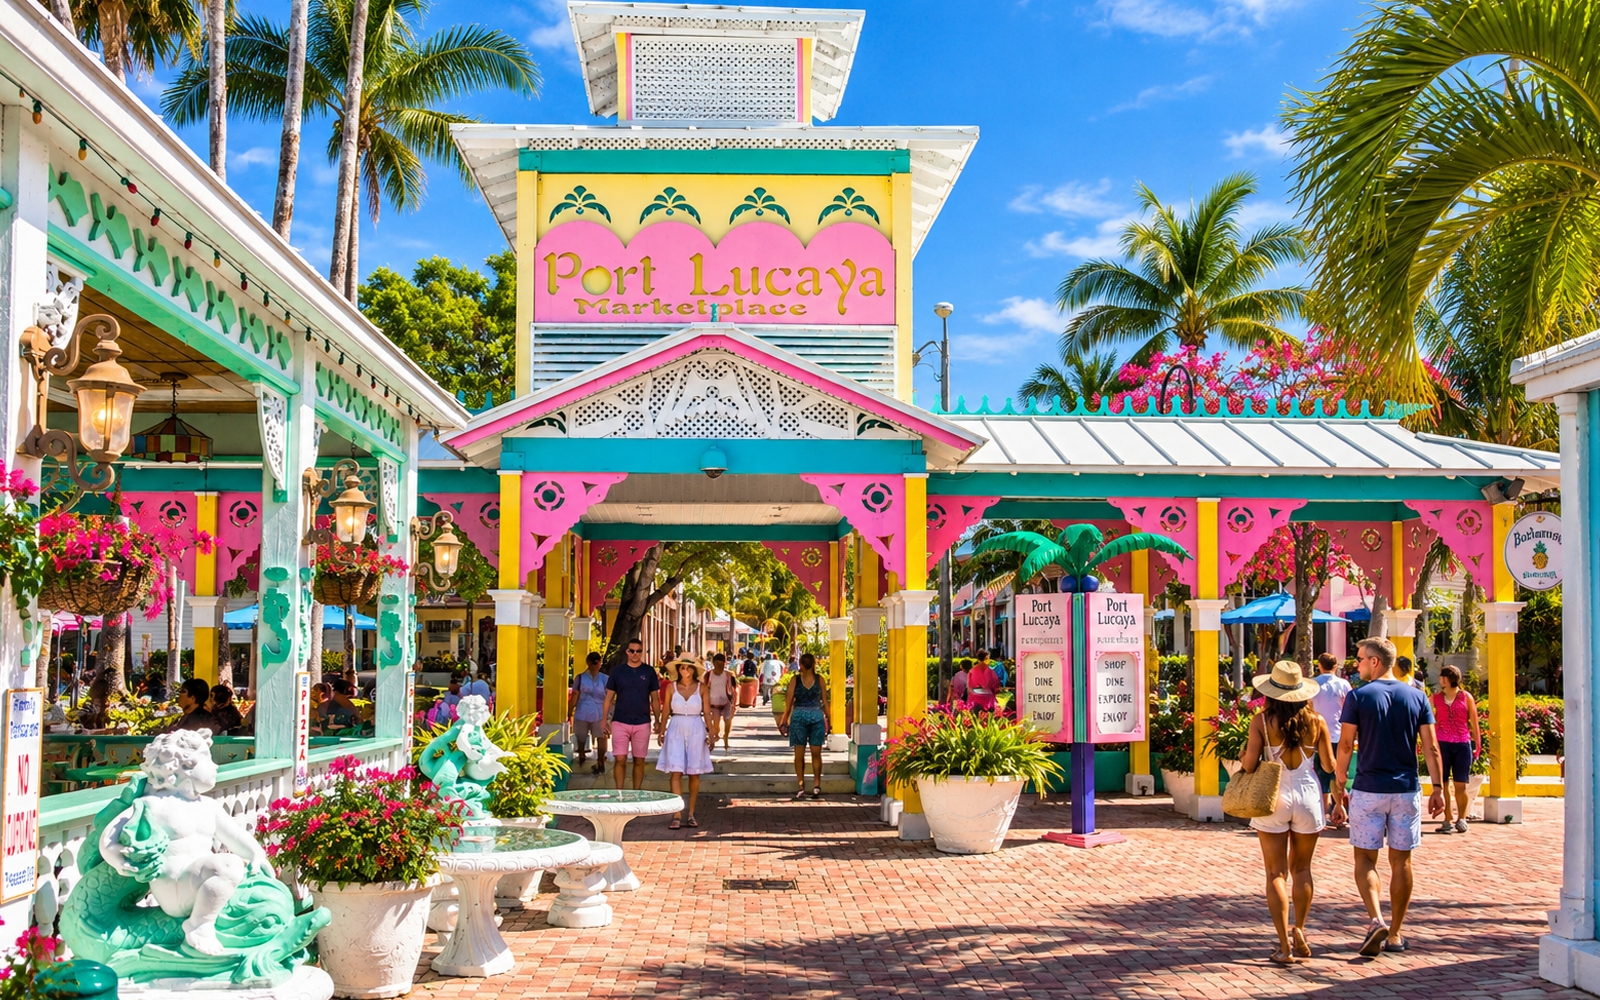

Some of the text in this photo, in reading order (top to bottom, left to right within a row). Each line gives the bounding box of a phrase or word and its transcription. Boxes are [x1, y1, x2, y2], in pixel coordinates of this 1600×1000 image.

[543, 252, 886, 315] Port Lucaya
[573, 298, 807, 316] Marketplace
[1032, 599, 1052, 613] Port
[1106, 598, 1128, 612] Port
[1033, 660, 1055, 669] SHOP
[1104, 660, 1127, 669] SHOP
[1034, 677, 1053, 687] DINE
[1106, 677, 1125, 687] DINE
[17, 753, 30, 796] NO
